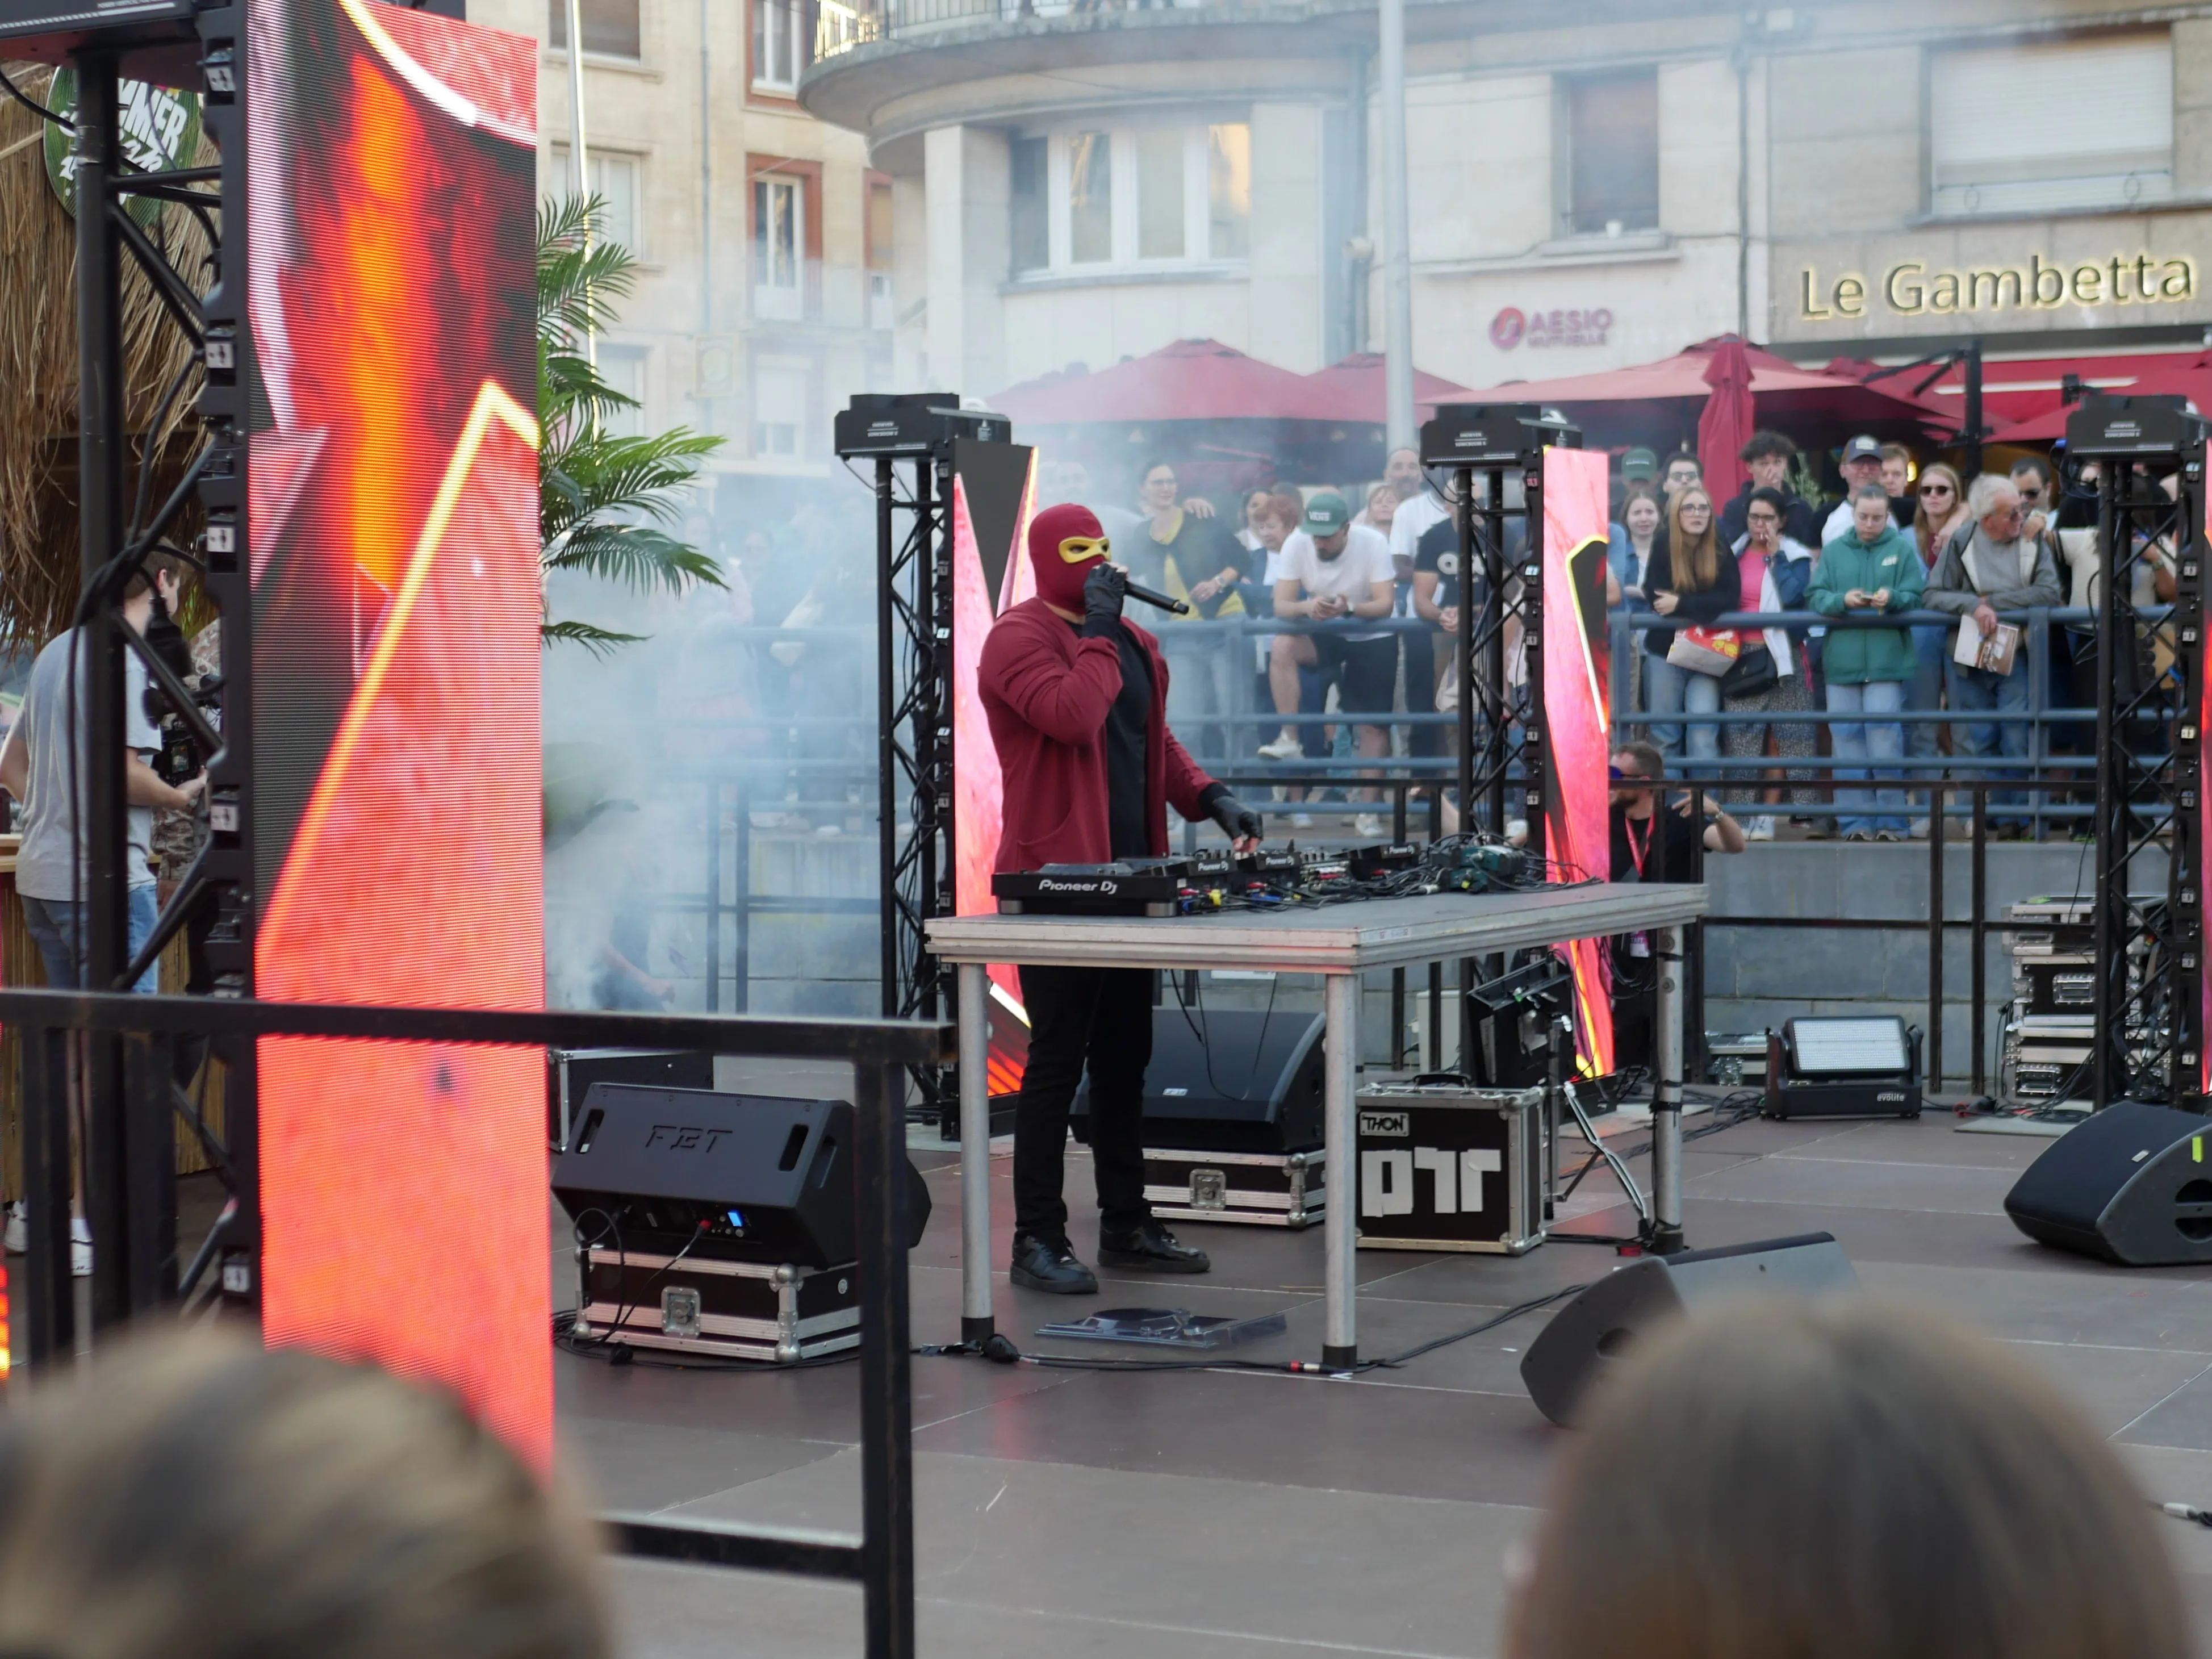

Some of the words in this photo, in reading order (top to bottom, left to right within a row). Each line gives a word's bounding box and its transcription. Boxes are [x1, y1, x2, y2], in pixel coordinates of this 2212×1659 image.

[1801, 270, 1864, 319] Le
[1884, 254, 2192, 314] Gambetta
[1038, 879, 1098, 892] Pioneer
[1876, 1092, 1905, 1102] evolite
[1362, 1114, 1404, 1132] THON
[645, 1125, 733, 1154] FBT
